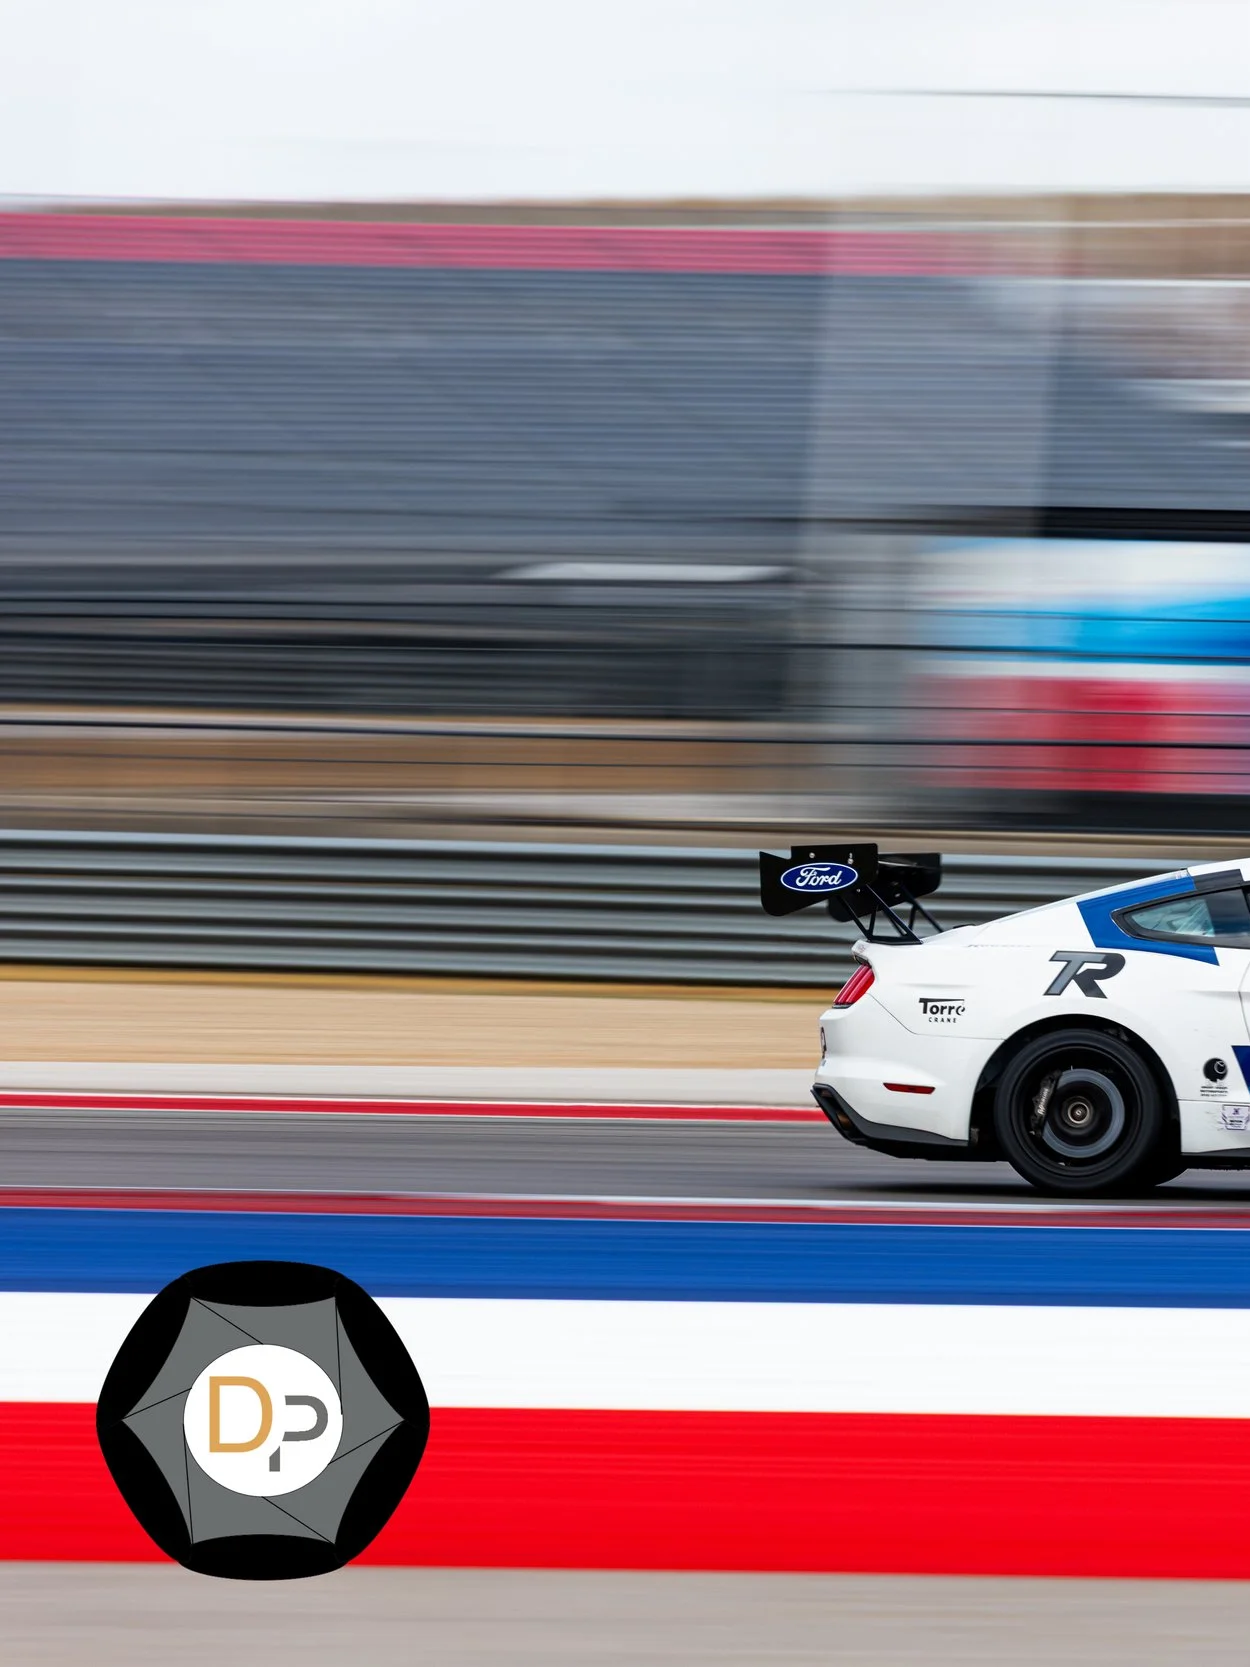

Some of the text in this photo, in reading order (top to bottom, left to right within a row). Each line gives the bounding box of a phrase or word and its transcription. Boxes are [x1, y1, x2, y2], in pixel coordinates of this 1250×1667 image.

[795, 865, 843, 887] Ford
[1043, 950, 1127, 999] TR
[918, 997, 966, 1016] Torre
